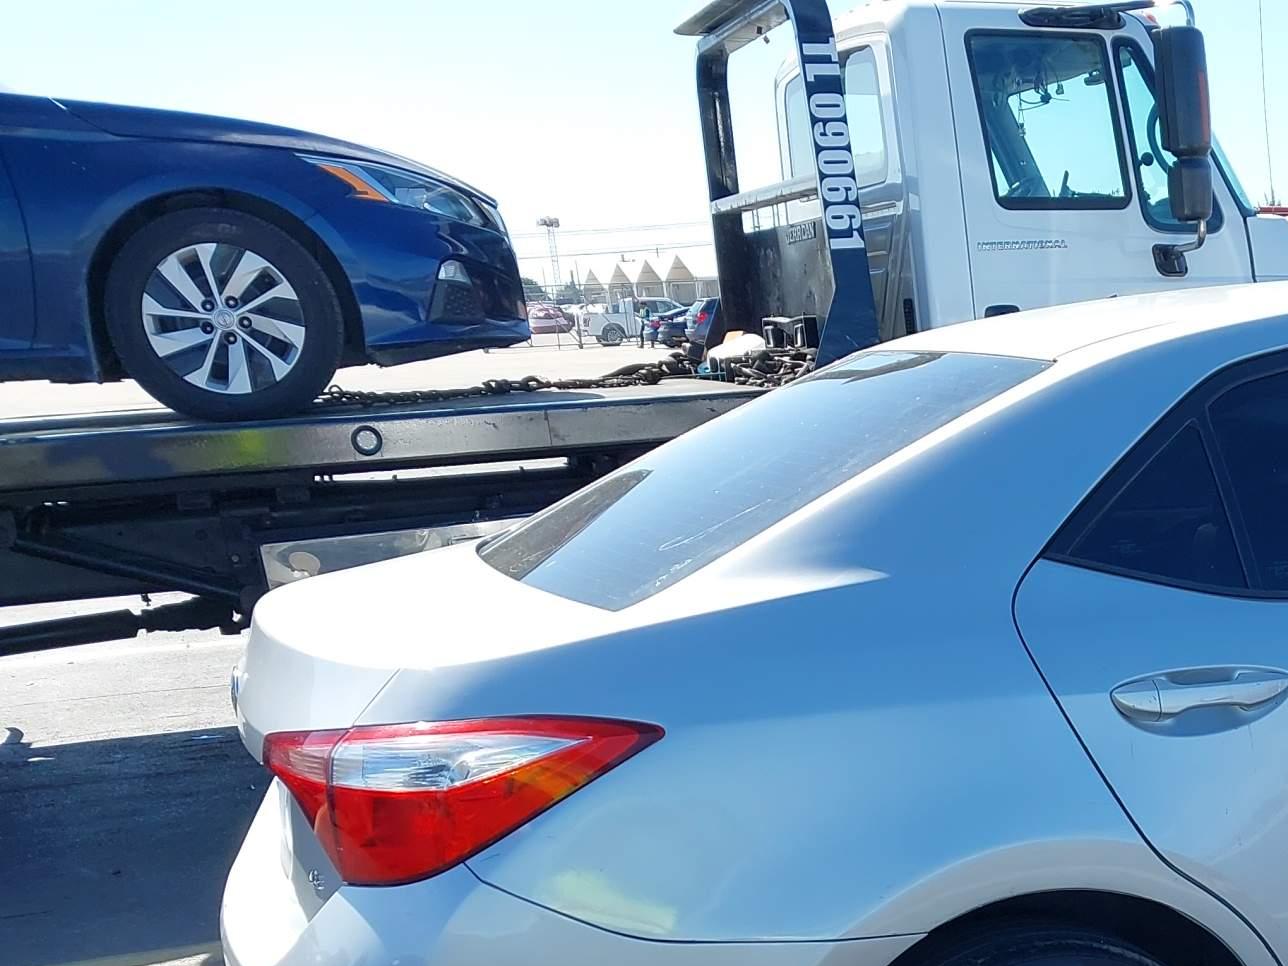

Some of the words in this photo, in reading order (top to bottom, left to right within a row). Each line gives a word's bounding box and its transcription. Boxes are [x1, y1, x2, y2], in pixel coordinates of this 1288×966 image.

[802, 37, 841, 82] TL
[809, 93, 865, 251] 090661
[977, 239, 1068, 251] INTERNATIONAL
